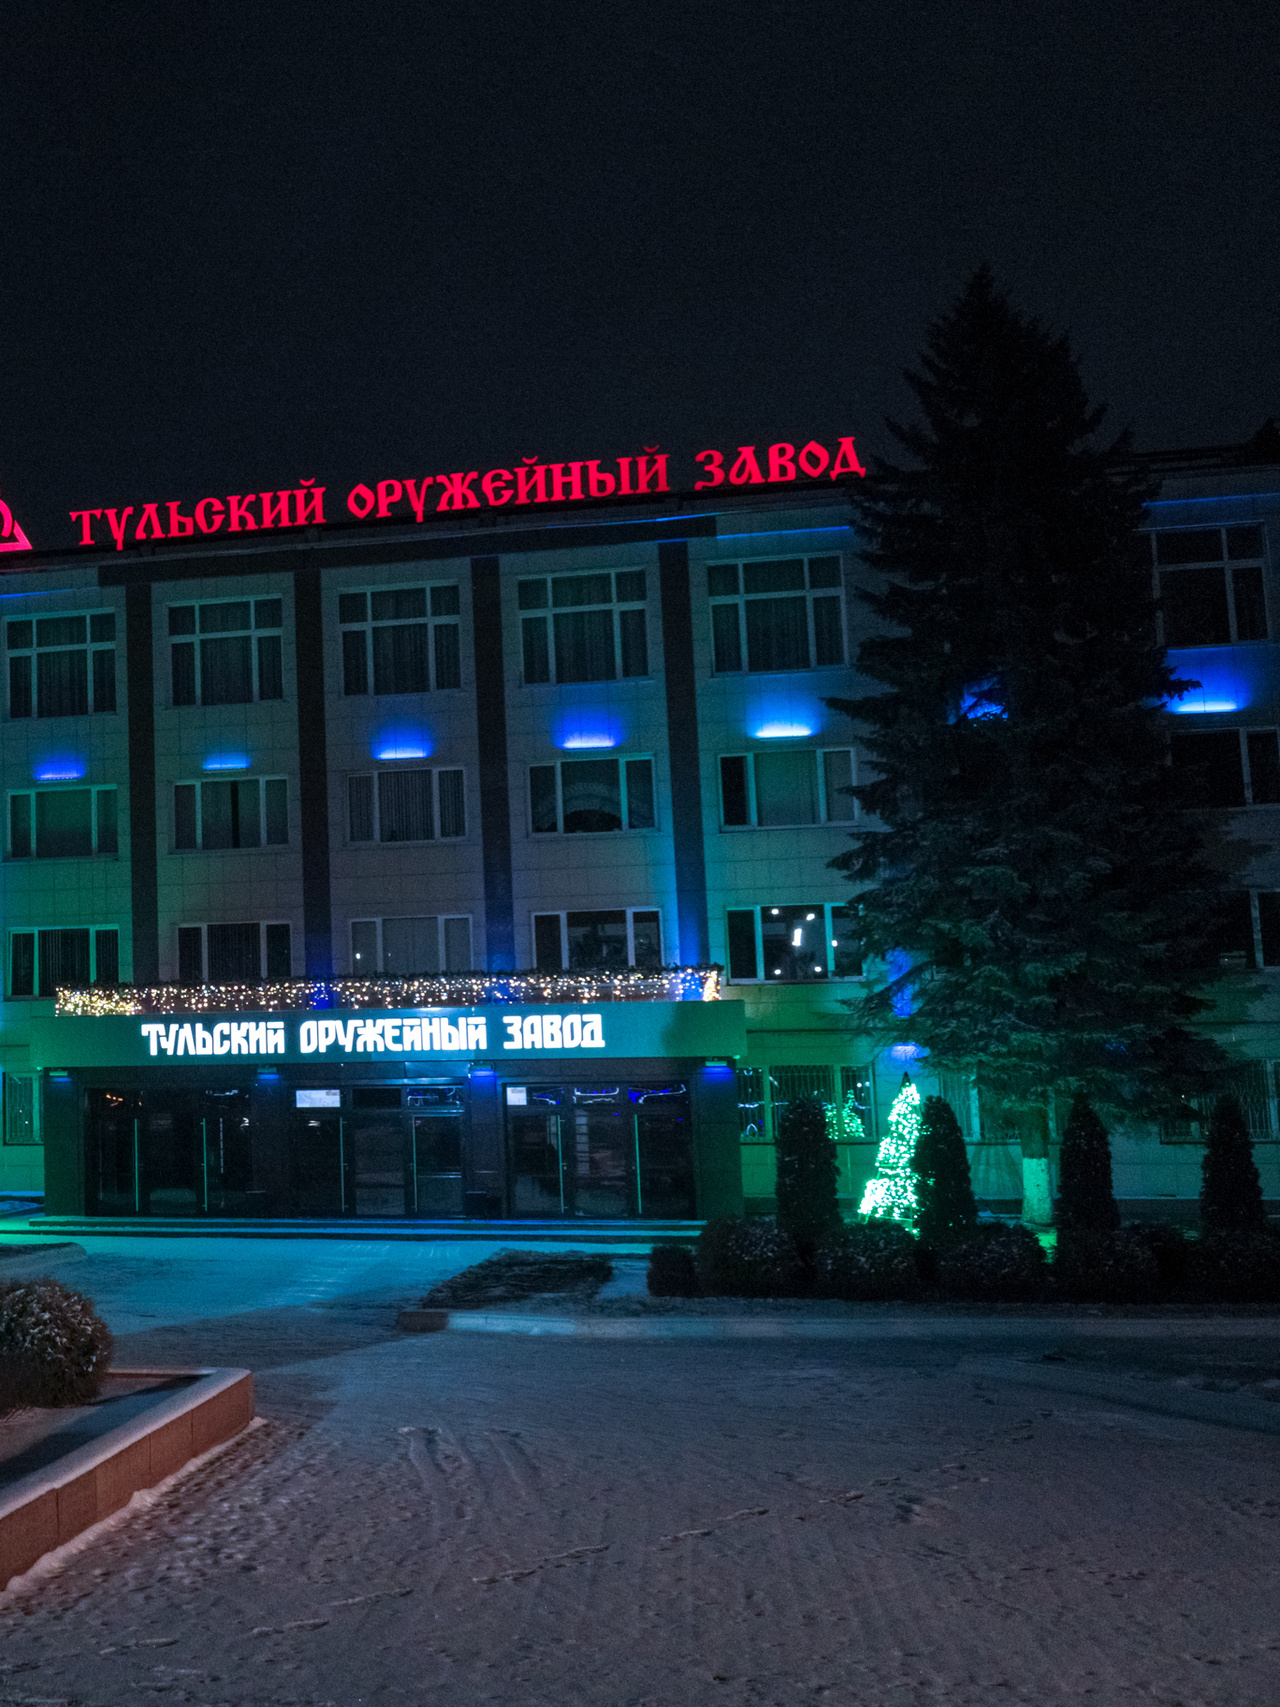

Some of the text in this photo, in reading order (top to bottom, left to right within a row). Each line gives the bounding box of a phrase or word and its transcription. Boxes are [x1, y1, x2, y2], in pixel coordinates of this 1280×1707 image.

[69, 436, 867, 551] ТУЛЬСКИЙ ОРУЖЕЙНЫЙ ЗАВОД
[141, 1013, 606, 1056] ТУЛЬСКИЙ ОРУЖЕЙНЫЙ ЗАВОД
